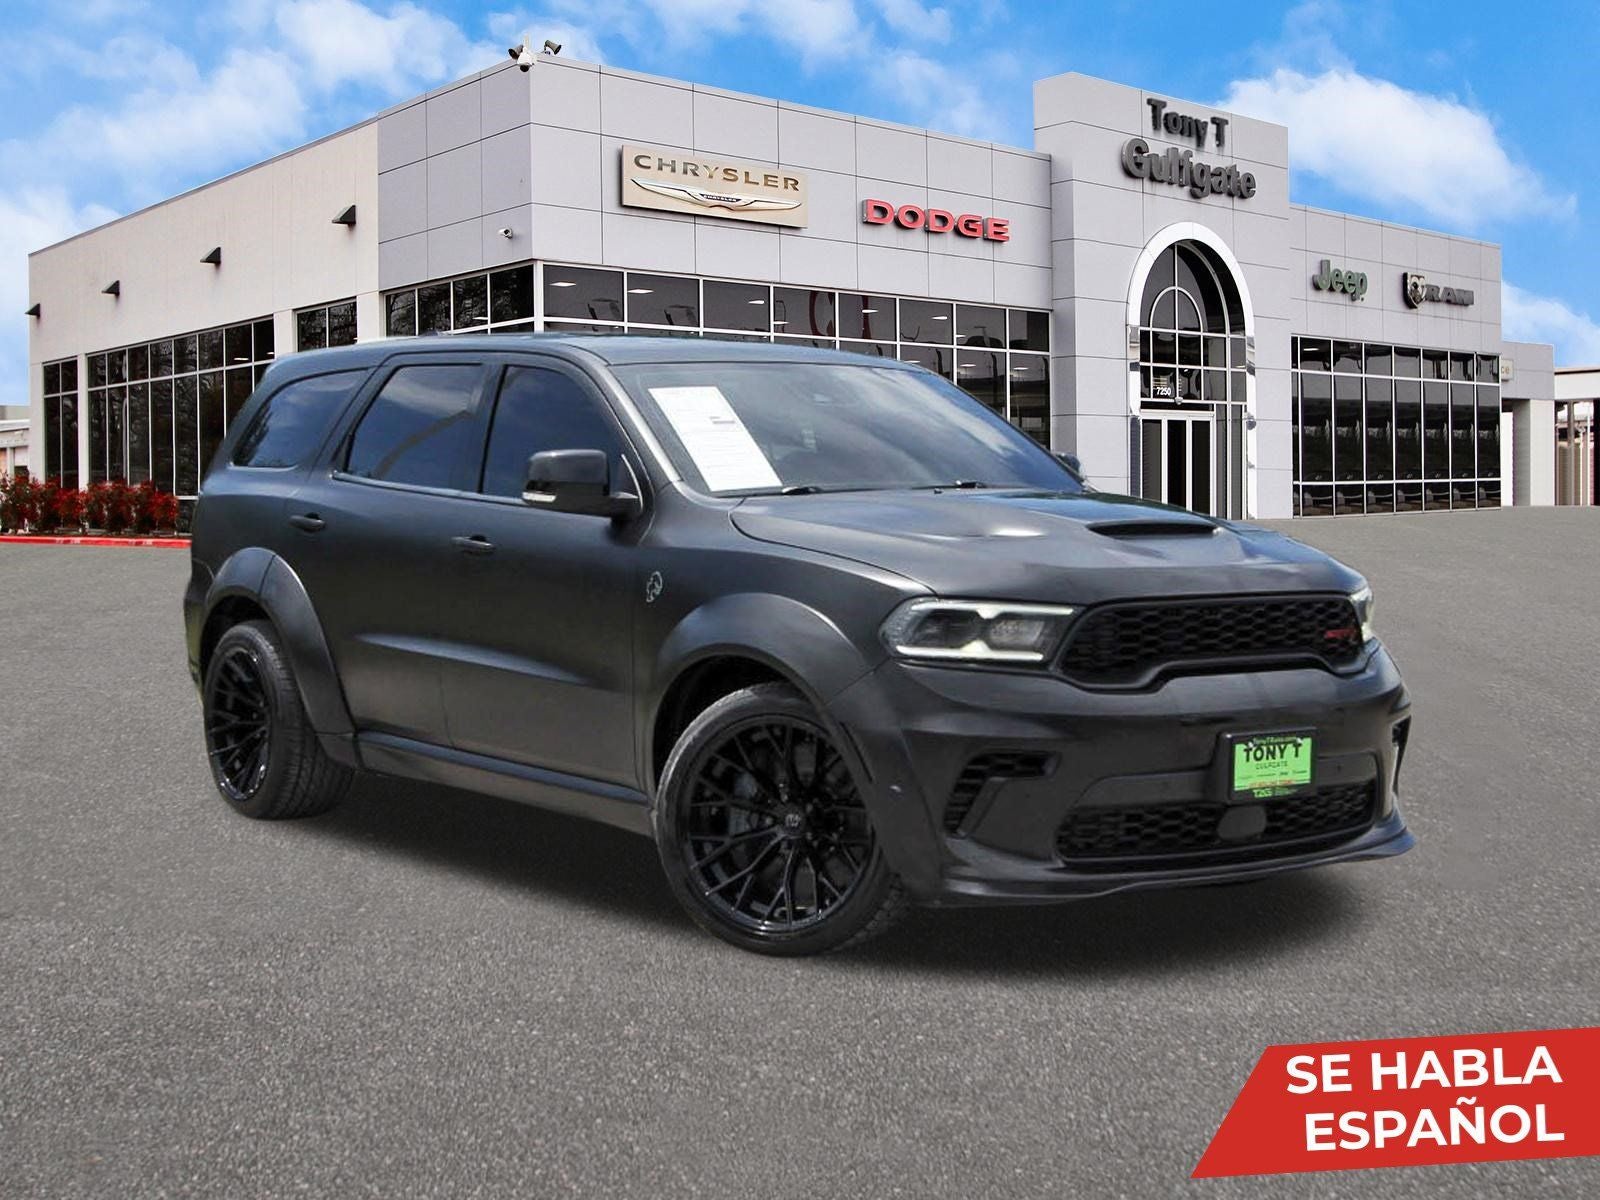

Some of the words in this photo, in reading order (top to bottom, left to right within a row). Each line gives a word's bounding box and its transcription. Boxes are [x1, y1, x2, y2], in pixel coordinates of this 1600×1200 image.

[1147, 98, 1208, 148] Tony
[1211, 117, 1229, 148] T
[633, 154, 800, 192] CHRYSLER
[1121, 138, 1257, 199] Gulfgate
[862, 198, 1011, 243] DODGE
[1311, 259, 1368, 302] Jeep
[1425, 284, 1475, 306] RAM
[1156, 386, 1171, 396] 7250
[1243, 743, 1289, 763] TONY
[1292, 742, 1303, 758] T
